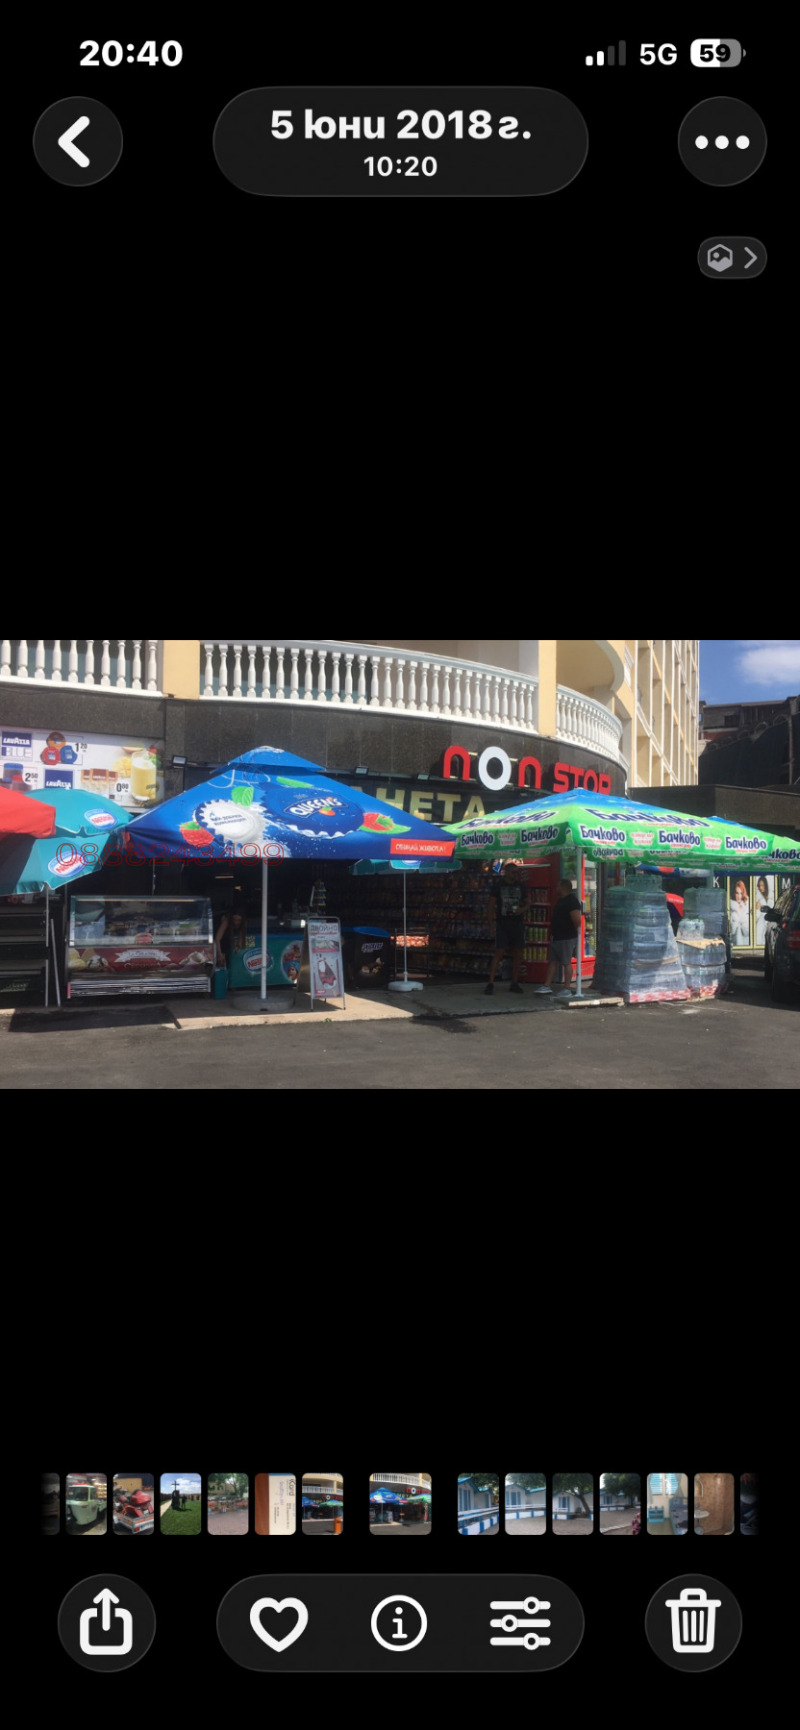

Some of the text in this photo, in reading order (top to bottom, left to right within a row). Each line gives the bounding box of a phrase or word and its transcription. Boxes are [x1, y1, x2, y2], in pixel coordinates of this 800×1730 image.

[553, 762, 612, 795] STOP
[461, 831, 494, 846] Бачково
[521, 825, 559, 842] Бачково
[579, 825, 626, 842] Бачково
[658, 829, 700, 846] Бачково
[725, 836, 767, 850] Бачково
